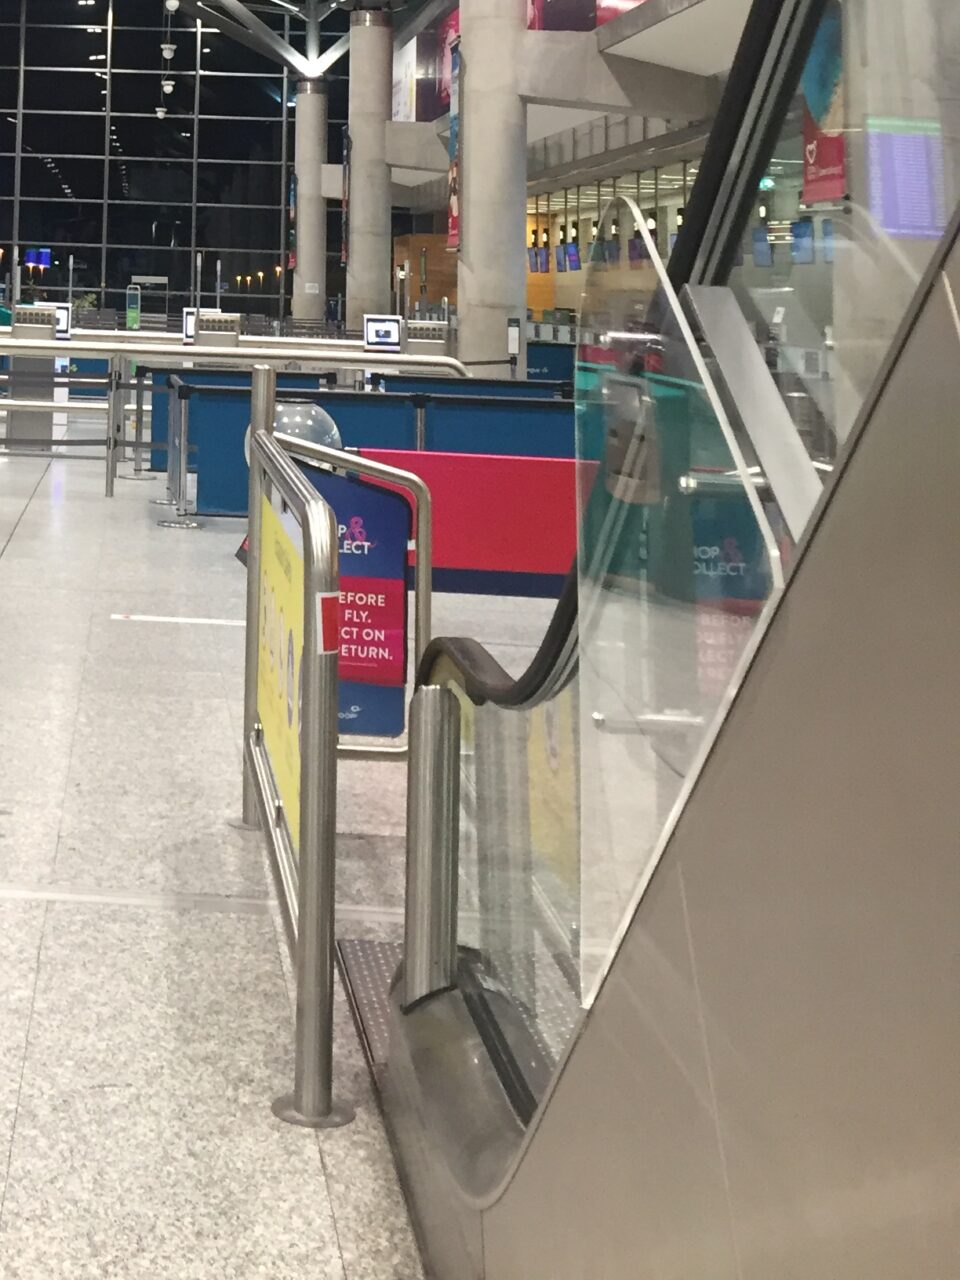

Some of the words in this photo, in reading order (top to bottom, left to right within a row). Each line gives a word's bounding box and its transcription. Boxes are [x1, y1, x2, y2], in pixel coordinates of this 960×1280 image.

[338, 591, 386, 607] EFORE
[344, 609, 372, 624] FLY.
[340, 626, 359, 640] CT
[362, 628, 385, 642] ON
[341, 643, 393, 660] ETURN.
